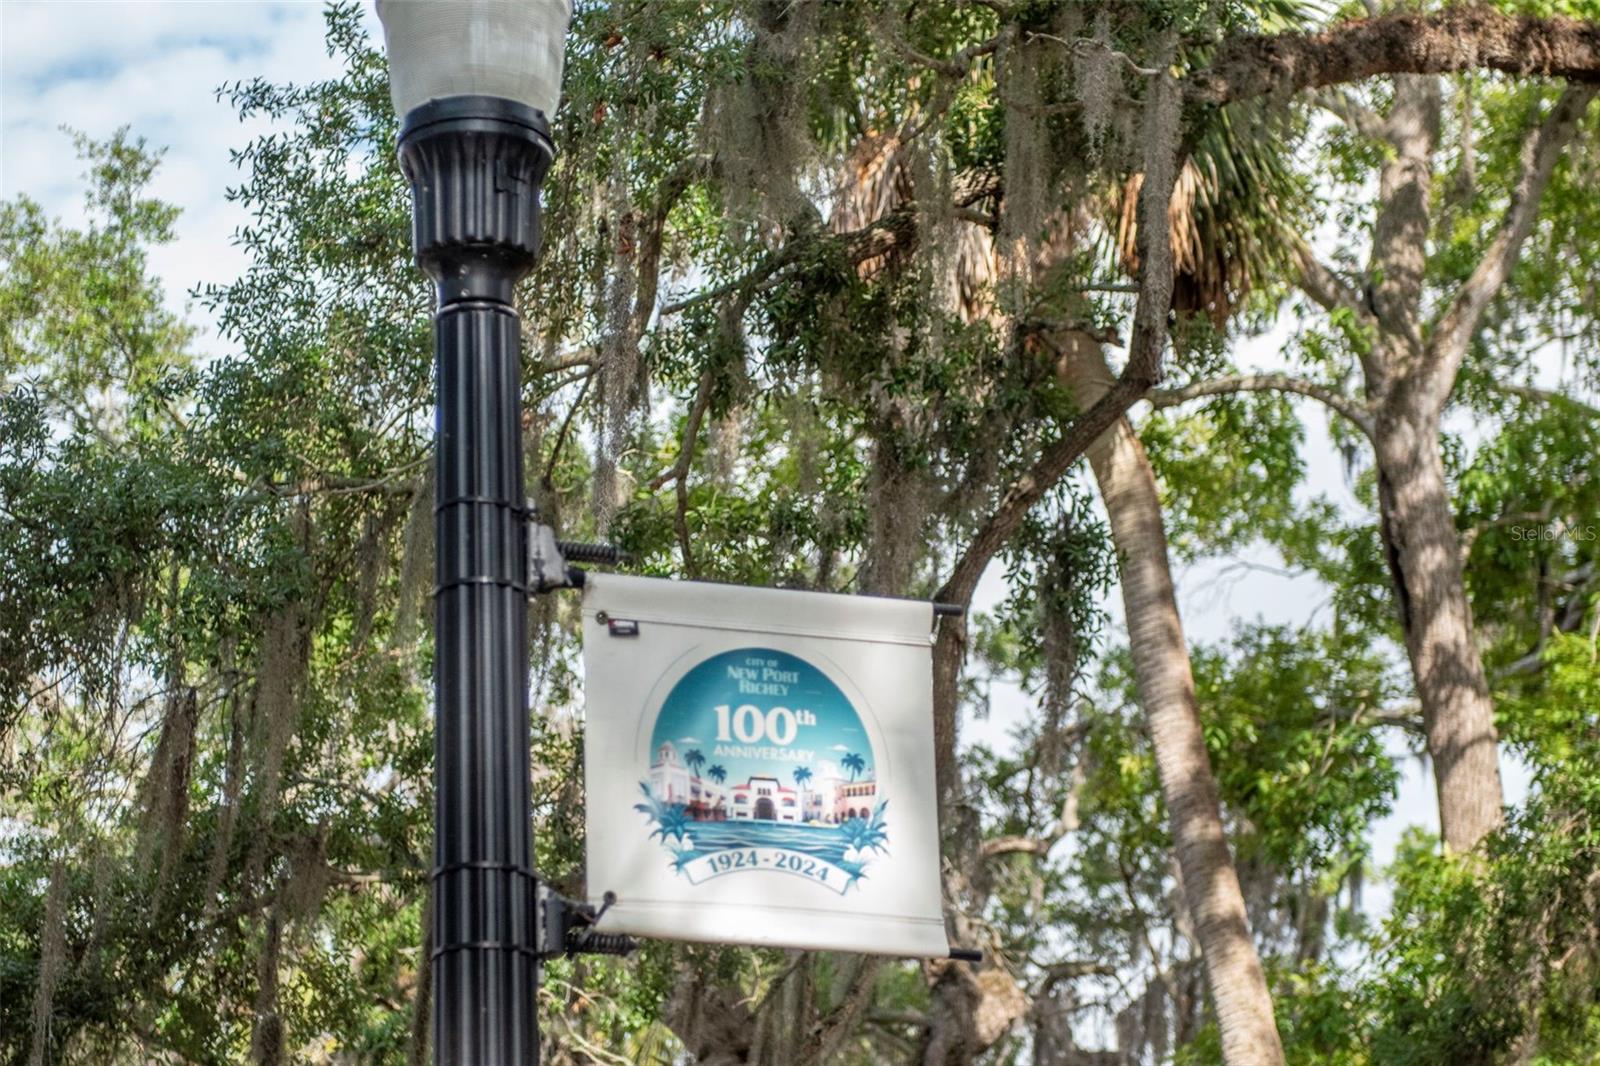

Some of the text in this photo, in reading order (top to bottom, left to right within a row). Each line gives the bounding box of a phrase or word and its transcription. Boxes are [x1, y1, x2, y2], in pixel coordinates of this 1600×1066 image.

[745, 658, 778, 668] CITY OF
[727, 665, 799, 683] NEW PORT
[739, 679, 790, 696] RICHEY
[713, 703, 817, 746] 100th
[714, 744, 816, 762] ANNIVERSARY
